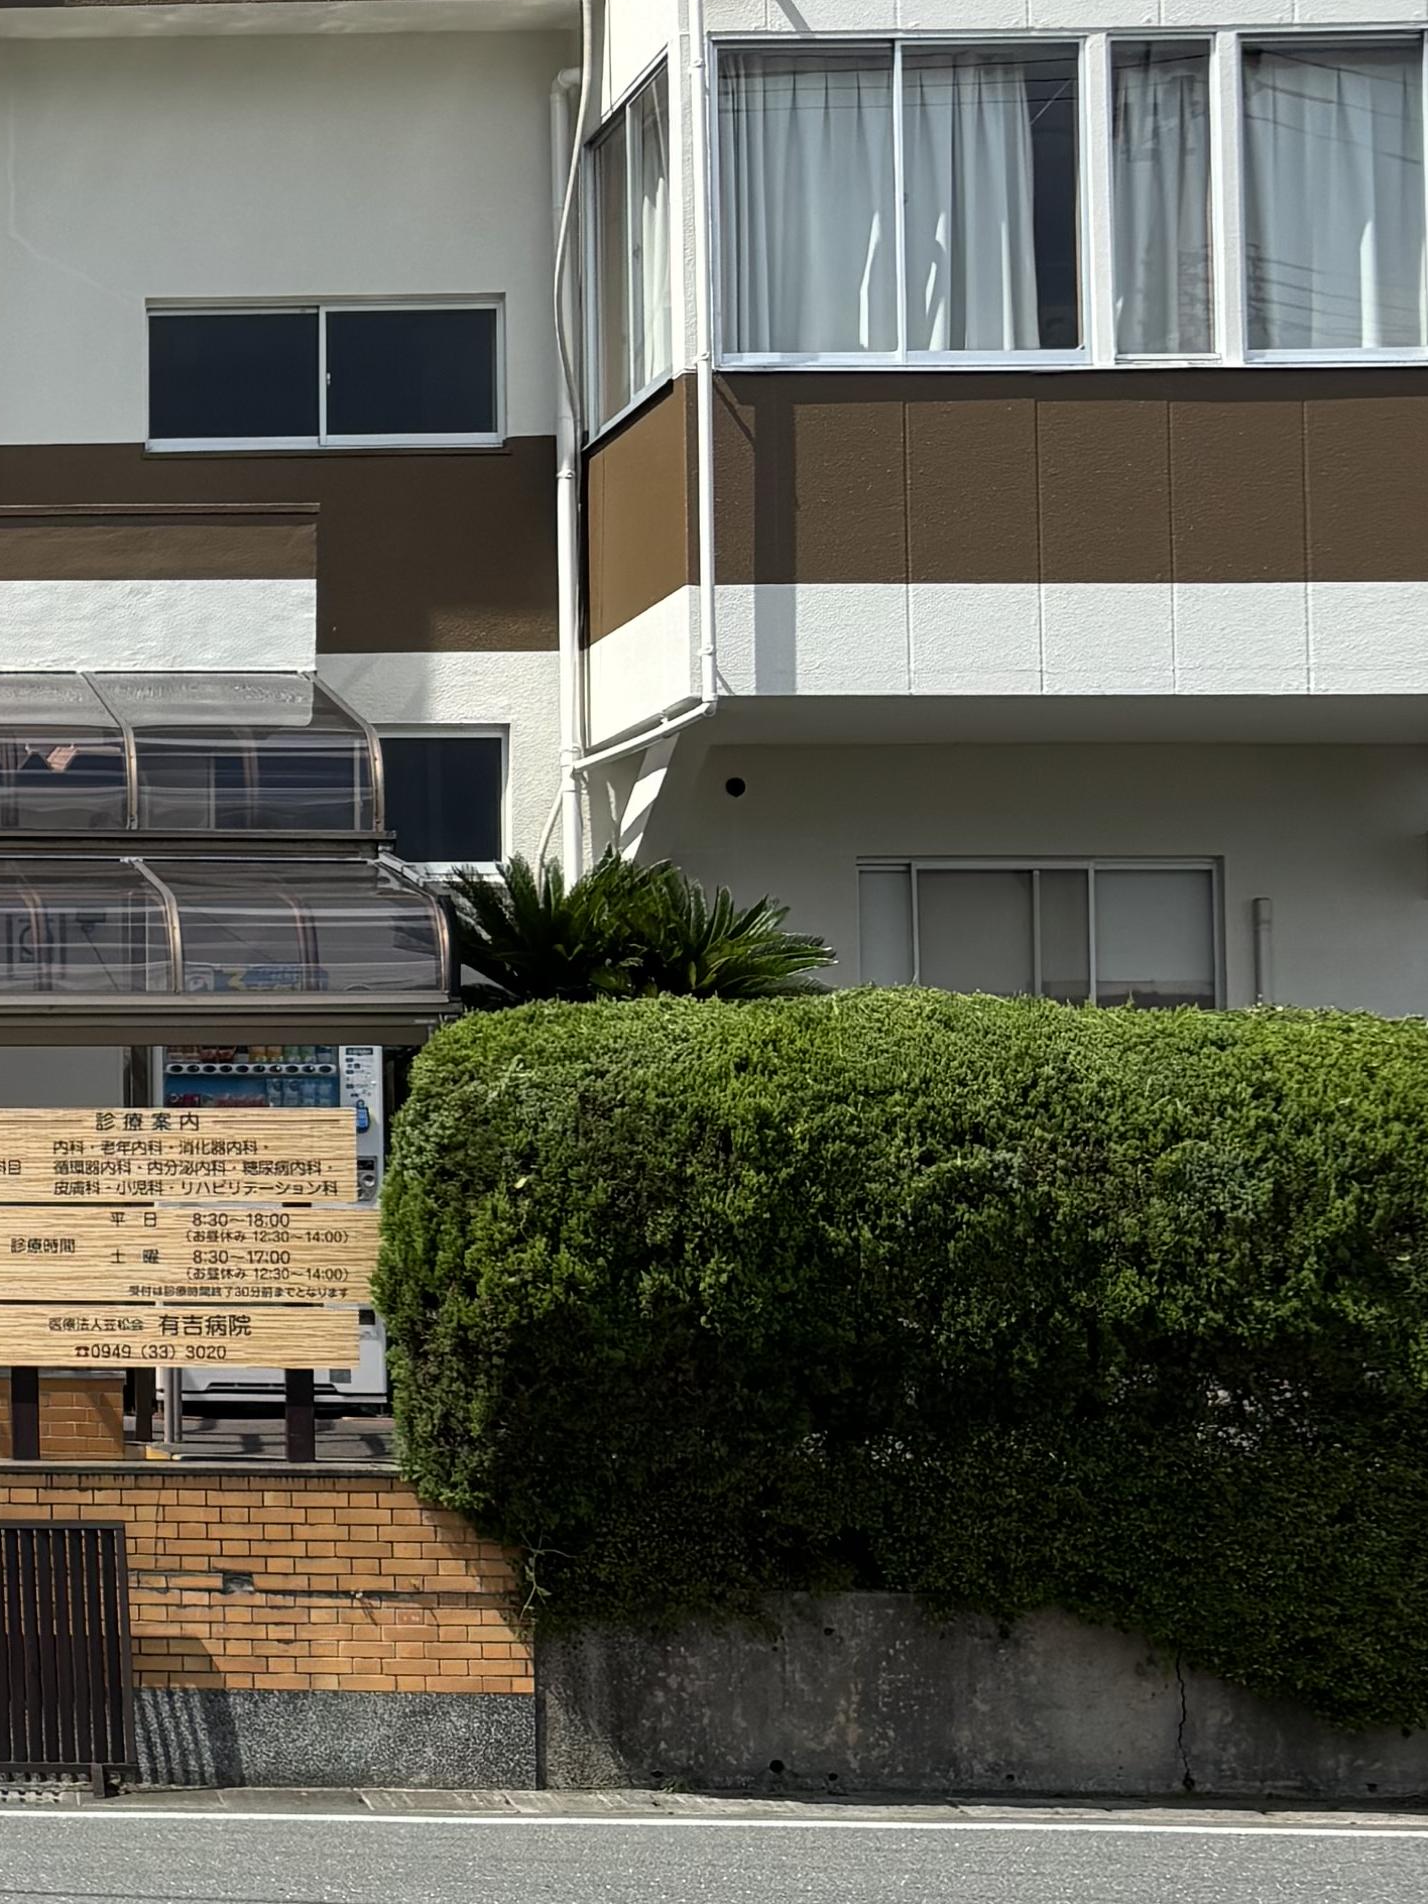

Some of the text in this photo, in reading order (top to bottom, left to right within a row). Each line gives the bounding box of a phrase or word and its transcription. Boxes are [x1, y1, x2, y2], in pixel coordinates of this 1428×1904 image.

[96, 1112, 200, 1132] 診療案内
[192, 1212, 290, 1228] 8:30～18:00
[11, 1238, 76, 1254] 診療時間
[192, 1249, 291, 1265] 8:30～17:00
[159, 1315, 252, 1336] 有吉病院
